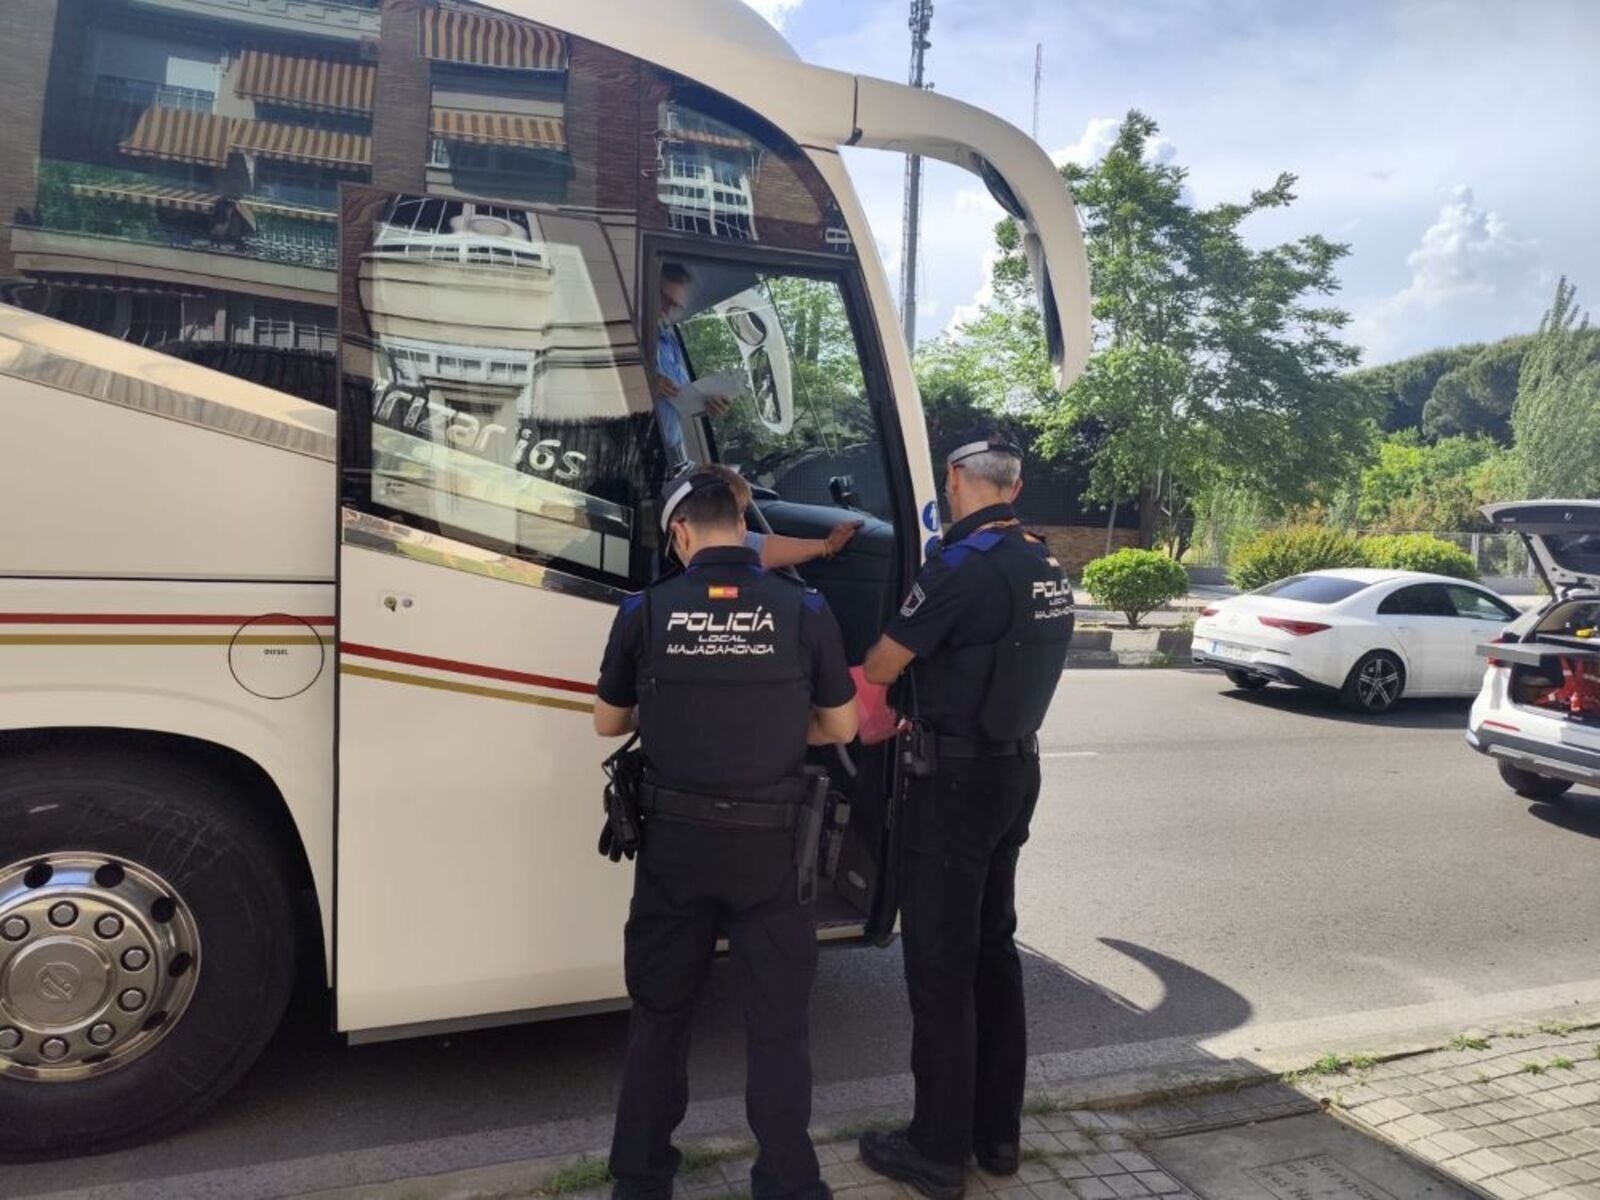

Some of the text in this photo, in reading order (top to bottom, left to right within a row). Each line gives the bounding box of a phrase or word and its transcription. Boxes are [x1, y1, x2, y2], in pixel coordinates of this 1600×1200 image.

[511, 428, 586, 480] i6s
[667, 605, 774, 631] POLICÍA
[666, 644, 774, 655] MAJADAHONDA
